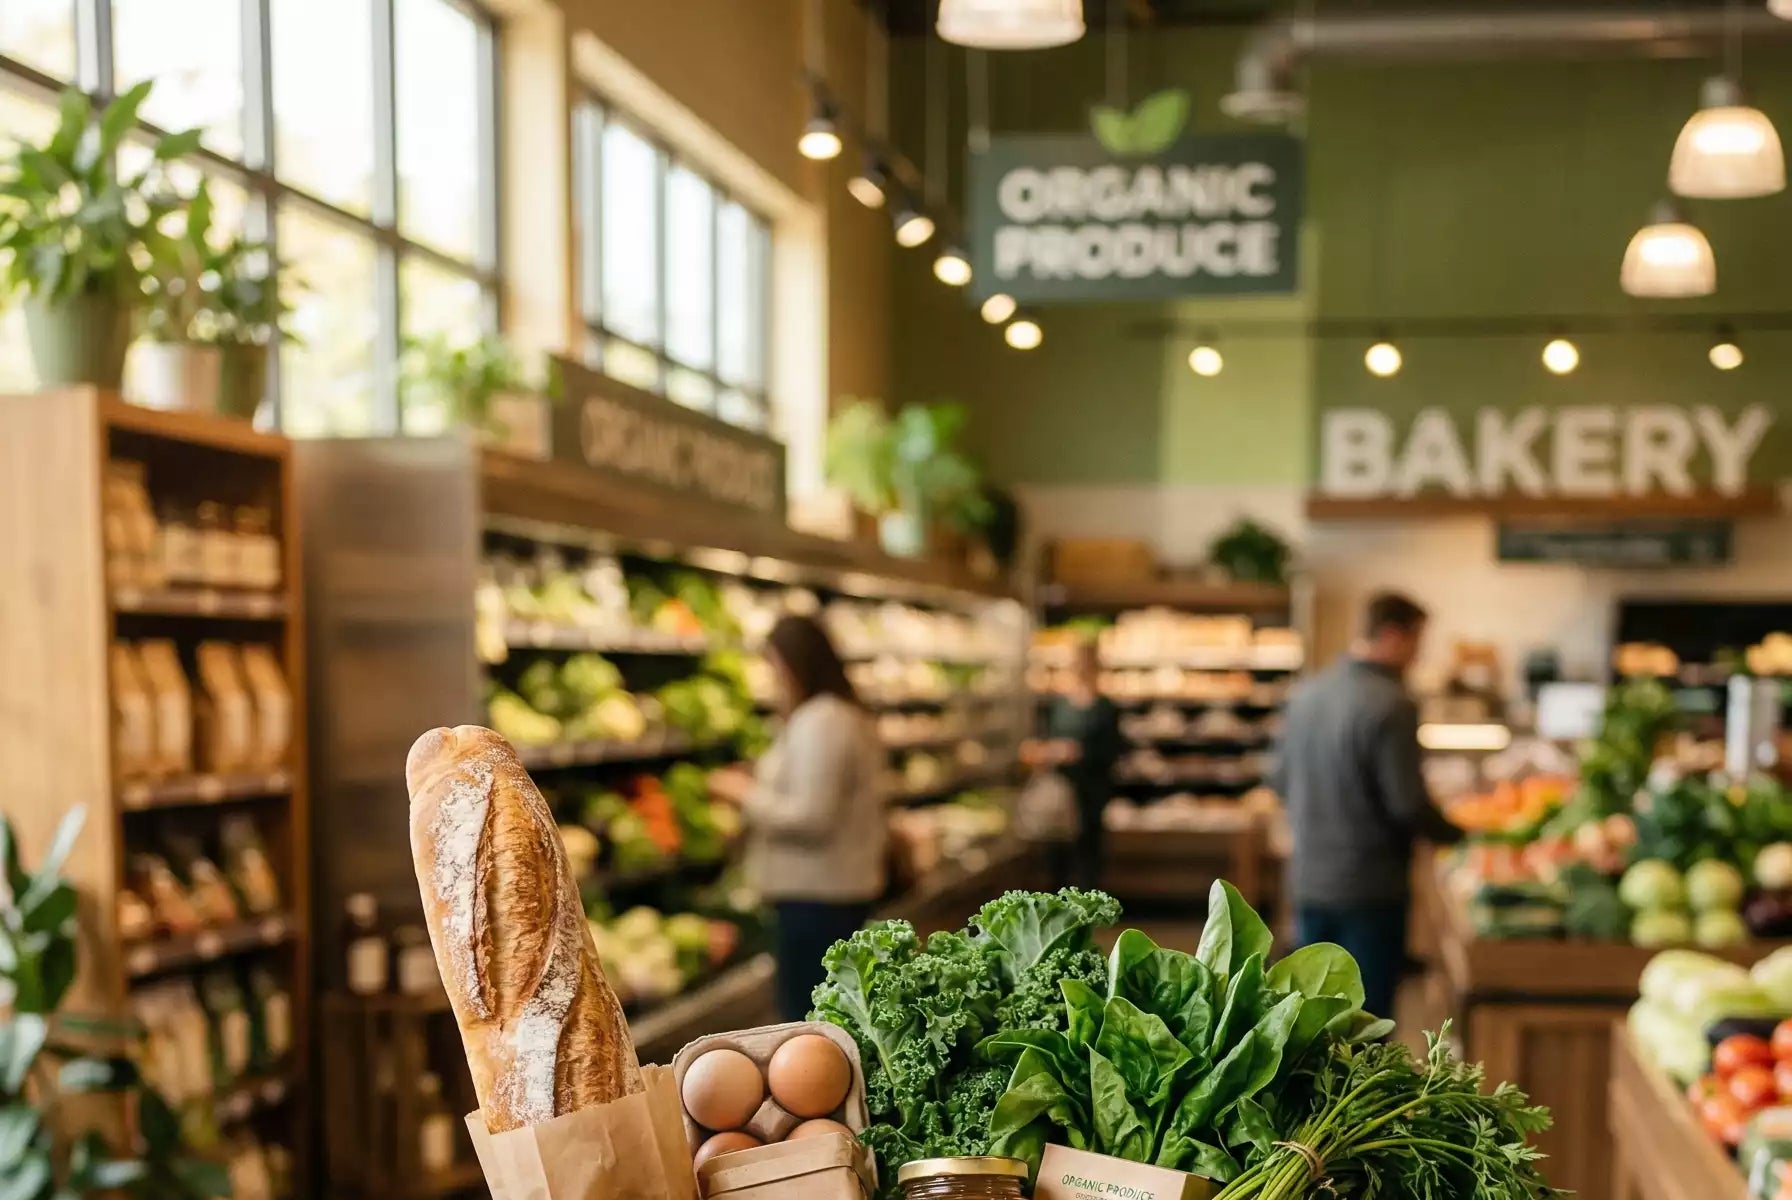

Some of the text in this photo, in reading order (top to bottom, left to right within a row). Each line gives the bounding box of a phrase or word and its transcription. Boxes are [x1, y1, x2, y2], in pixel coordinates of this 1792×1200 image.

[999, 163, 1275, 222] ORGANIC
[994, 222, 1279, 278] PRODUCE
[1321, 405, 1771, 497] BAKERY
[1061, 1174, 1104, 1193] ORGANIC
